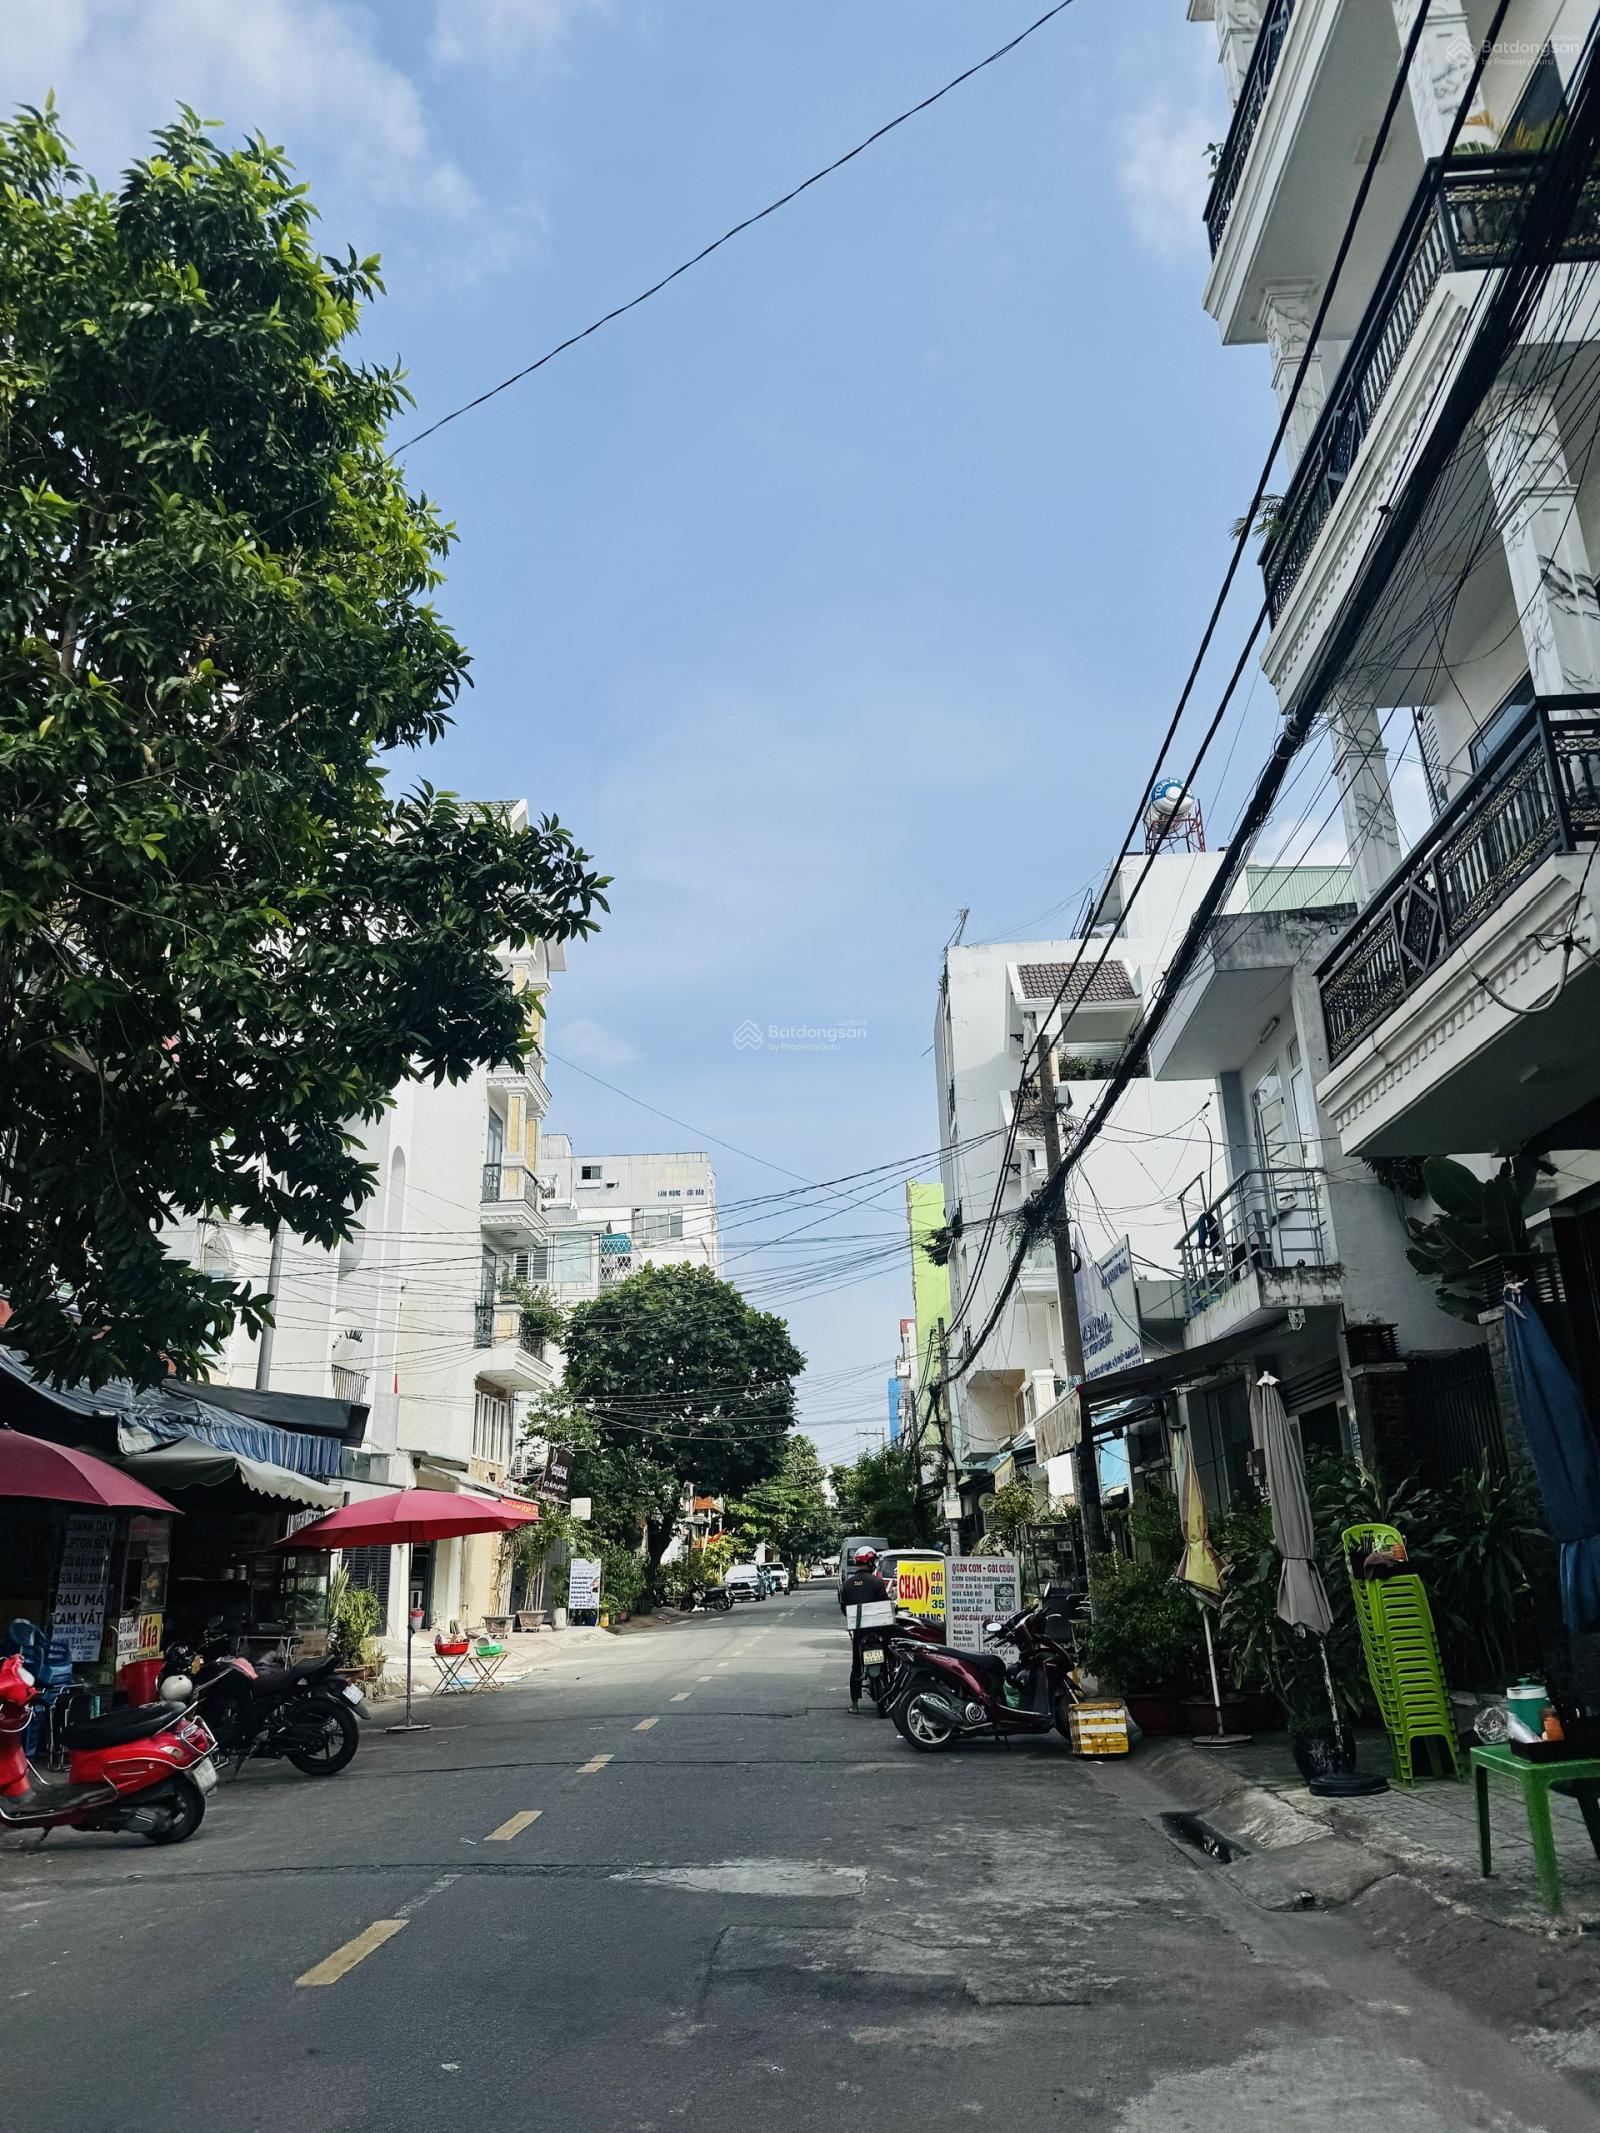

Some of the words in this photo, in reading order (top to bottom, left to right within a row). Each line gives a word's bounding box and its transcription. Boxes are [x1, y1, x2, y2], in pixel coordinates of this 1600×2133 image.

[56, 1593, 80, 1606] RAU
[84, 1590, 104, 1606] MÁ
[54, 1612, 79, 1625] CAM
